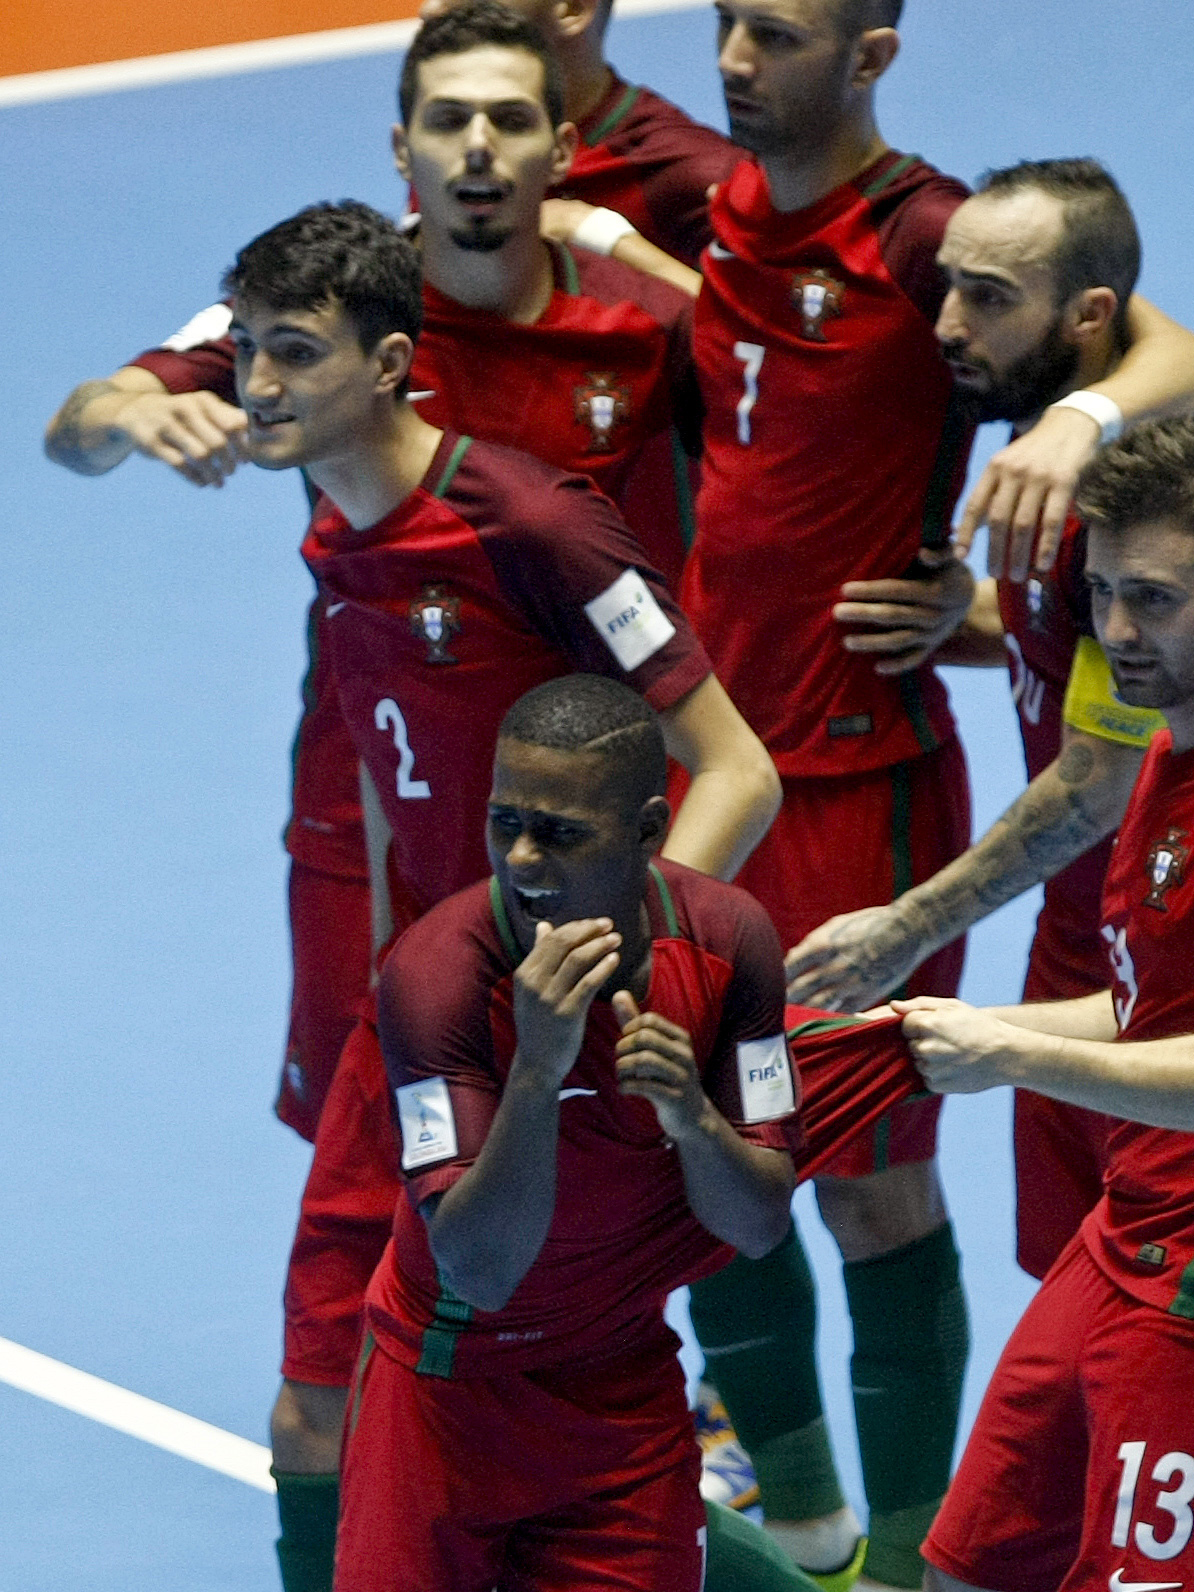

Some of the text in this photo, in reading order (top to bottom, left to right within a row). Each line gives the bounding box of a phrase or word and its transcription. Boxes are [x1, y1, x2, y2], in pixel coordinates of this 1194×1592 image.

[733, 340, 766, 445] 7
[606, 605, 640, 634] FIFA
[374, 697, 432, 798] 2
[748, 1065, 778, 1082] FIFA
